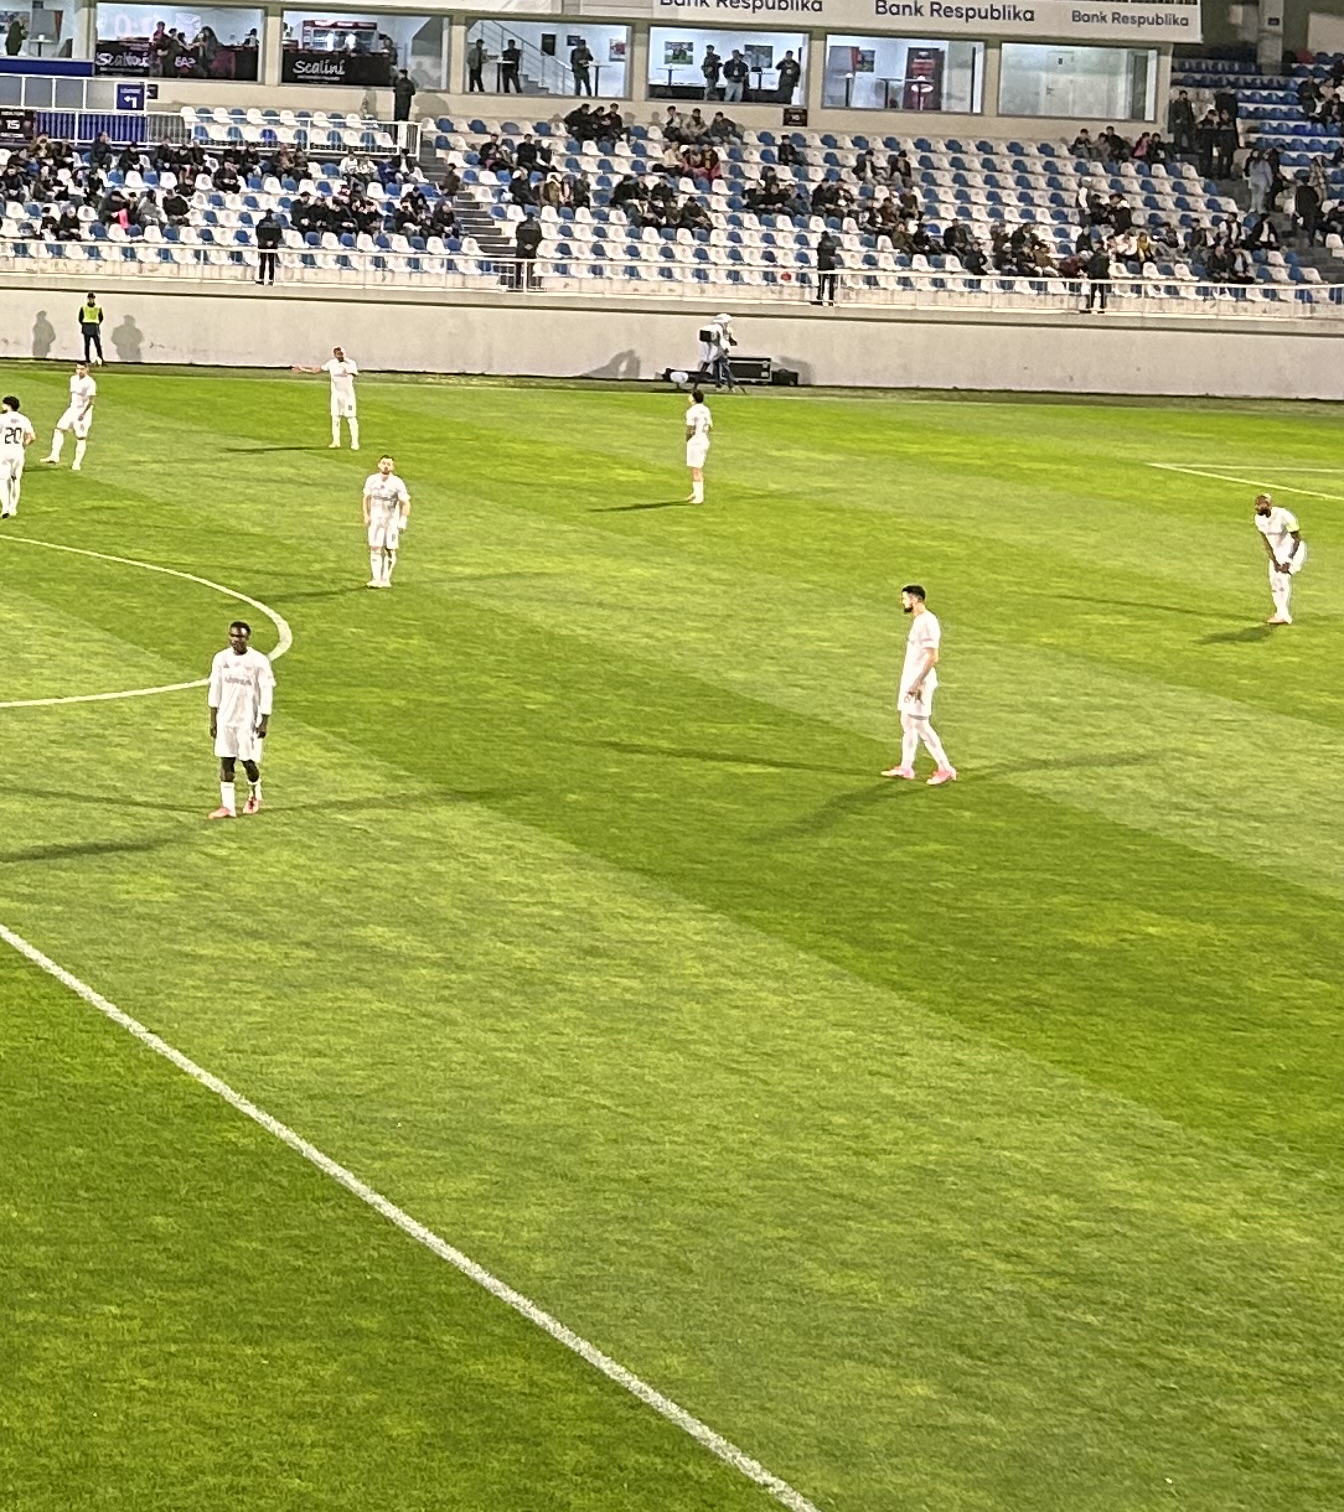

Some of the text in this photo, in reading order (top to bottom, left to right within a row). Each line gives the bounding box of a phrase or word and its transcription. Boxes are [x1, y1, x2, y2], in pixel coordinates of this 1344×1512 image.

[876, 0, 1035, 23] Bank Respublika
[1072, 10, 1190, 28] Bank Respublika
[292, 58, 346, 76] Scalini
[4, 426, 22, 445] 20
